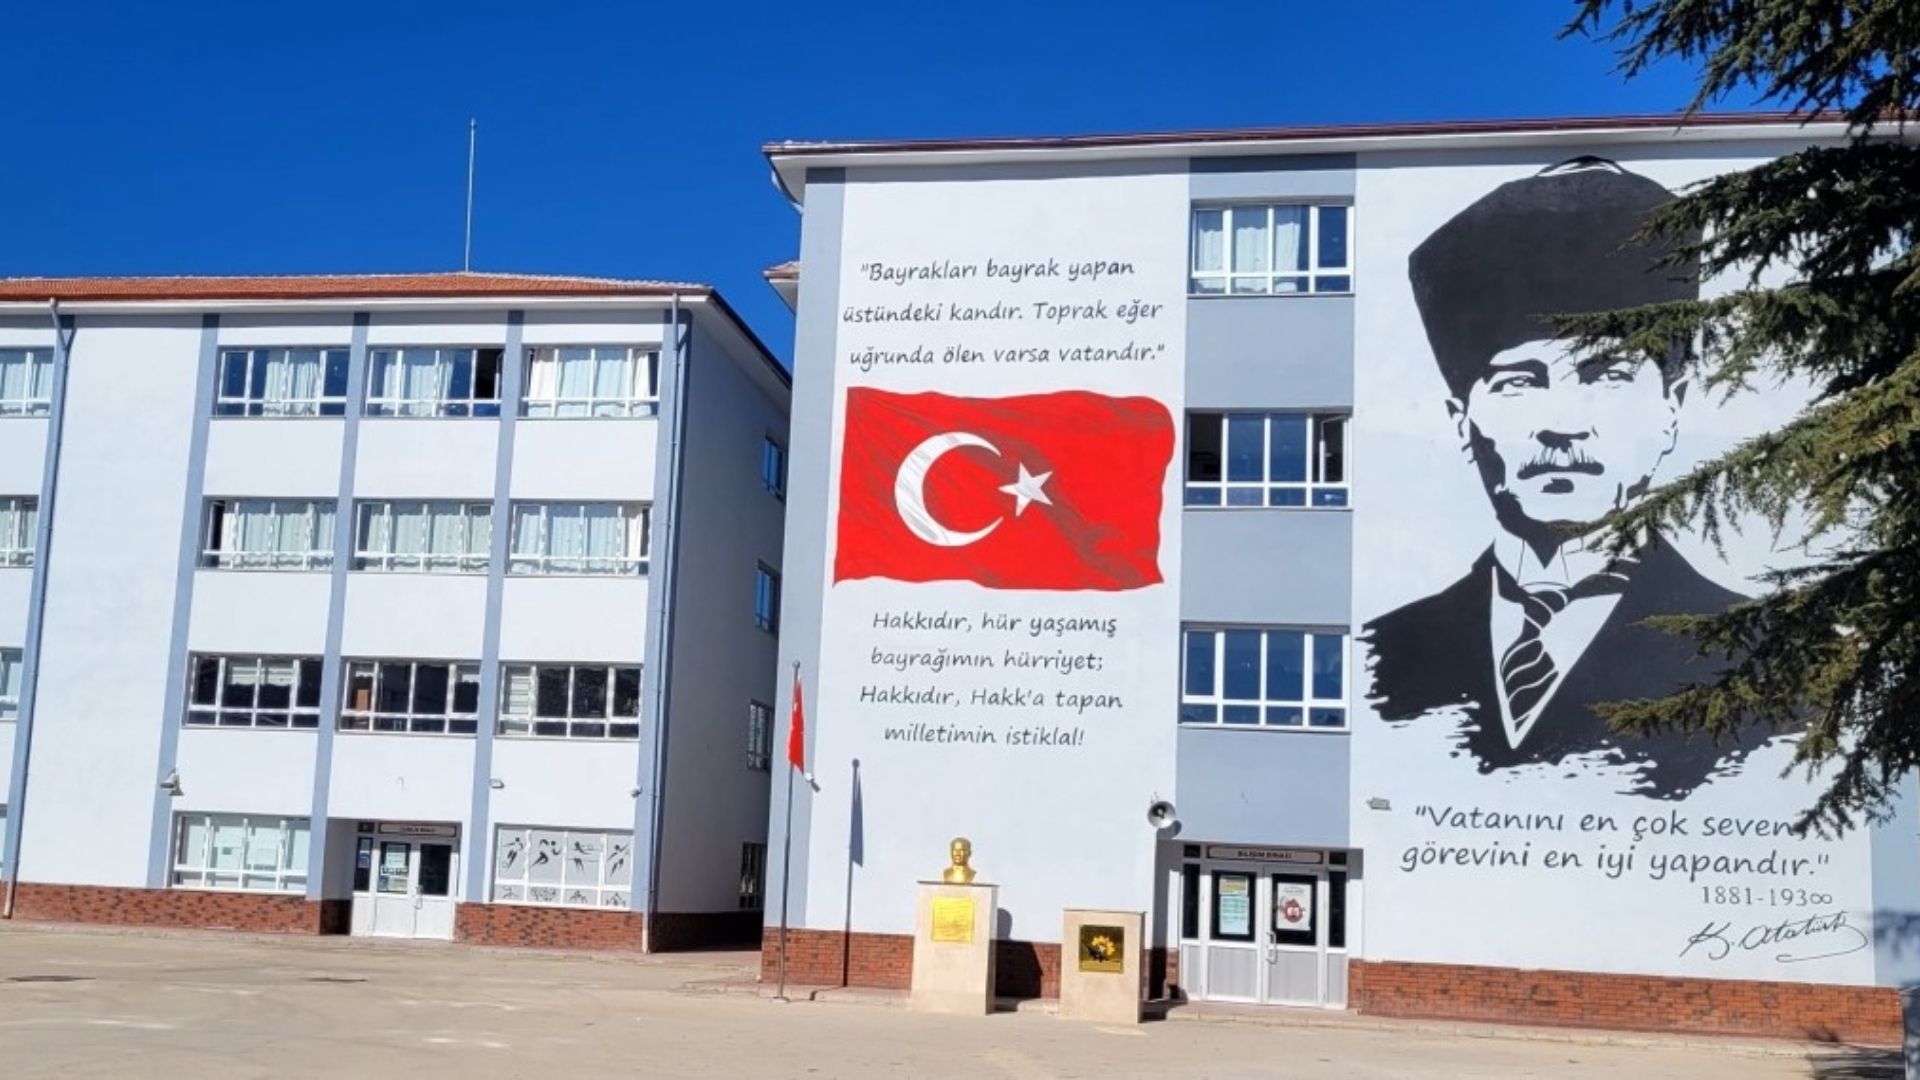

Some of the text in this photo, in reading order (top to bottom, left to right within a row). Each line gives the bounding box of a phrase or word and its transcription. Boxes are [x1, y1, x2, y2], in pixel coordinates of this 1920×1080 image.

[861, 258, 1135, 286] "Bayrakları bayrak yapan
[842, 299, 1163, 325] üstündeki kandır. Toprak eğer
[850, 341, 1165, 372] uğrunda ölen varsa vatandır."
[873, 611, 1118, 638] Hakkıdır, hür yaşamış
[871, 646, 1103, 675] bayrağımın hürriyet;
[860, 685, 1123, 715] Hakkıdır, Hakk'a tapan
[885, 723, 1084, 746] milletimin istiklal!
[1415, 804, 1564, 832] "Vatanını
[1579, 814, 1618, 833] en
[1631, 810, 1688, 842] çok
[1400, 841, 1830, 883] görevini en iyi yapandır."
